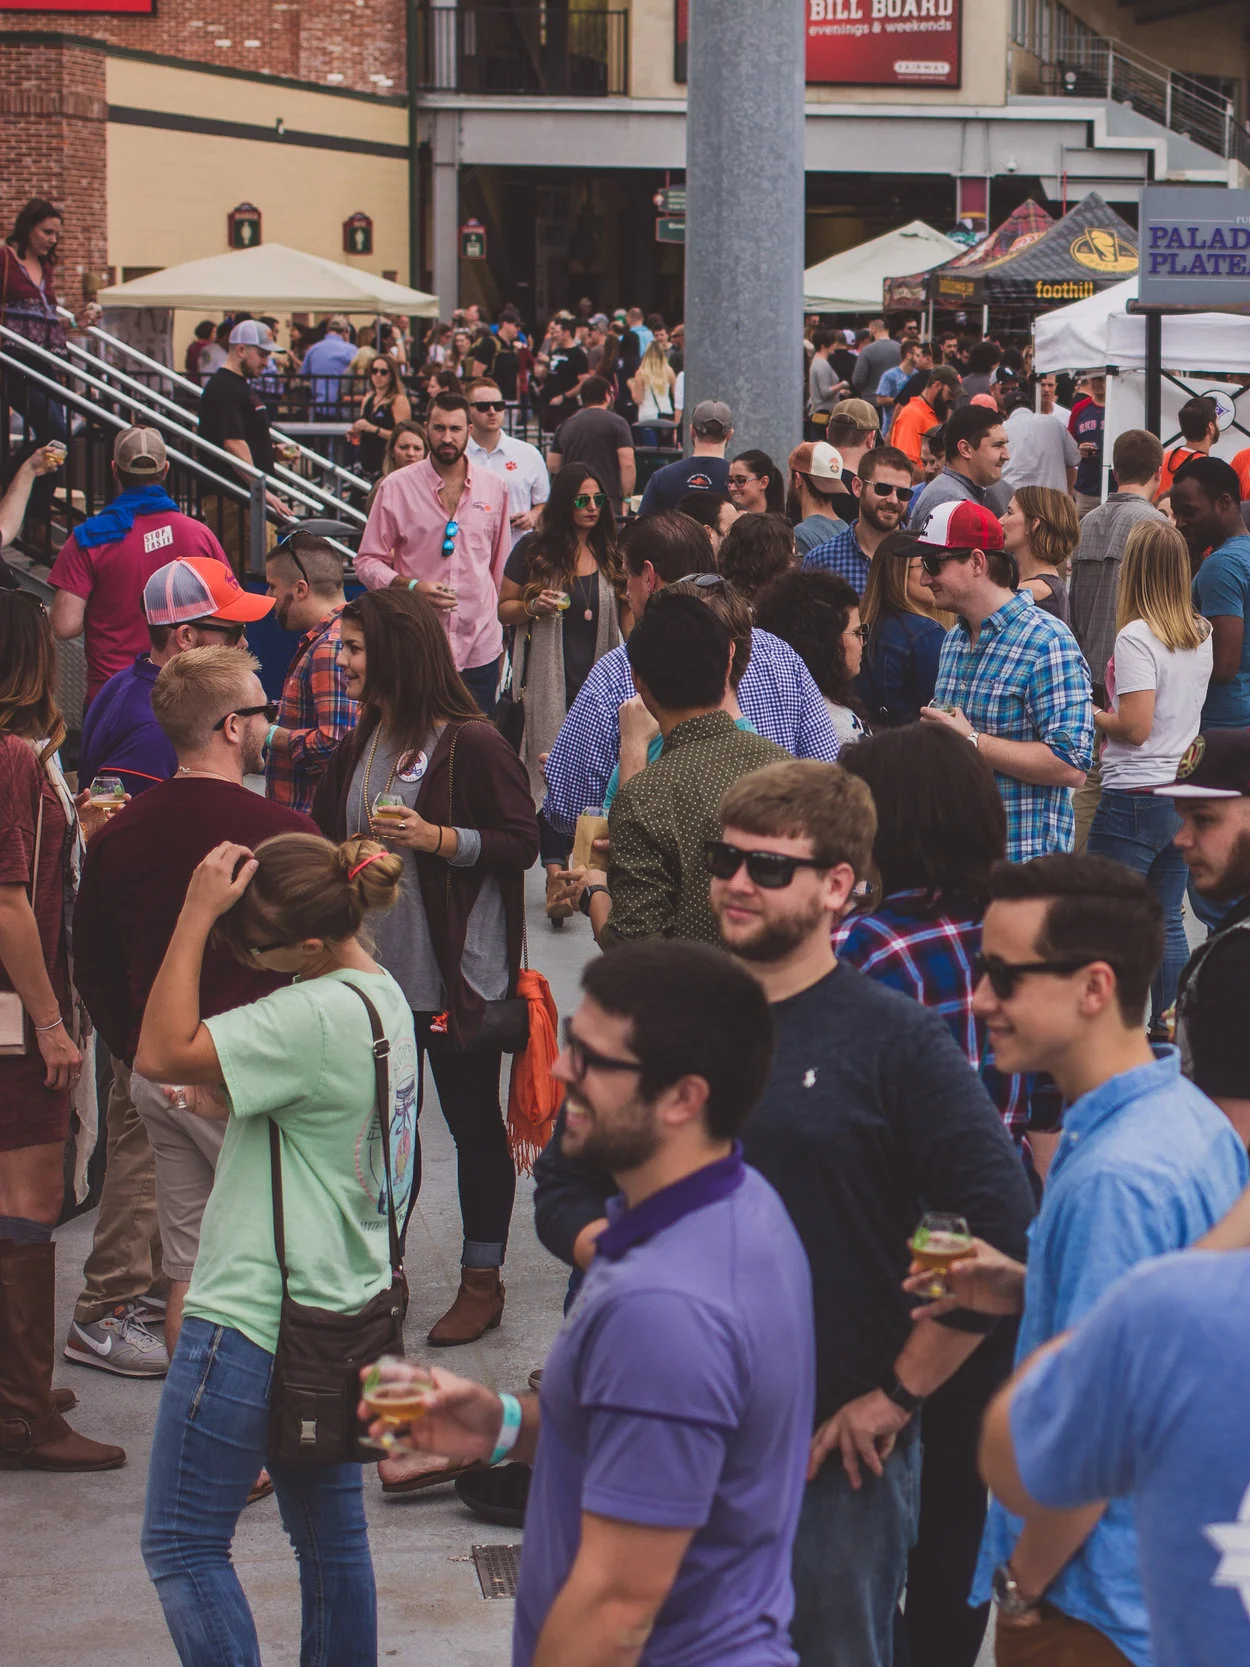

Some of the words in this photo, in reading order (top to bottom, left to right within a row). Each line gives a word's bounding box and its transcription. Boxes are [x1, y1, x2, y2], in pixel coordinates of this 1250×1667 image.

[810, 0, 863, 20] BILL
[871, 0, 954, 18] BOARD
[808, 22, 869, 37] evenings
[872, 21, 882, 33] &
[885, 18, 952, 32] weekends
